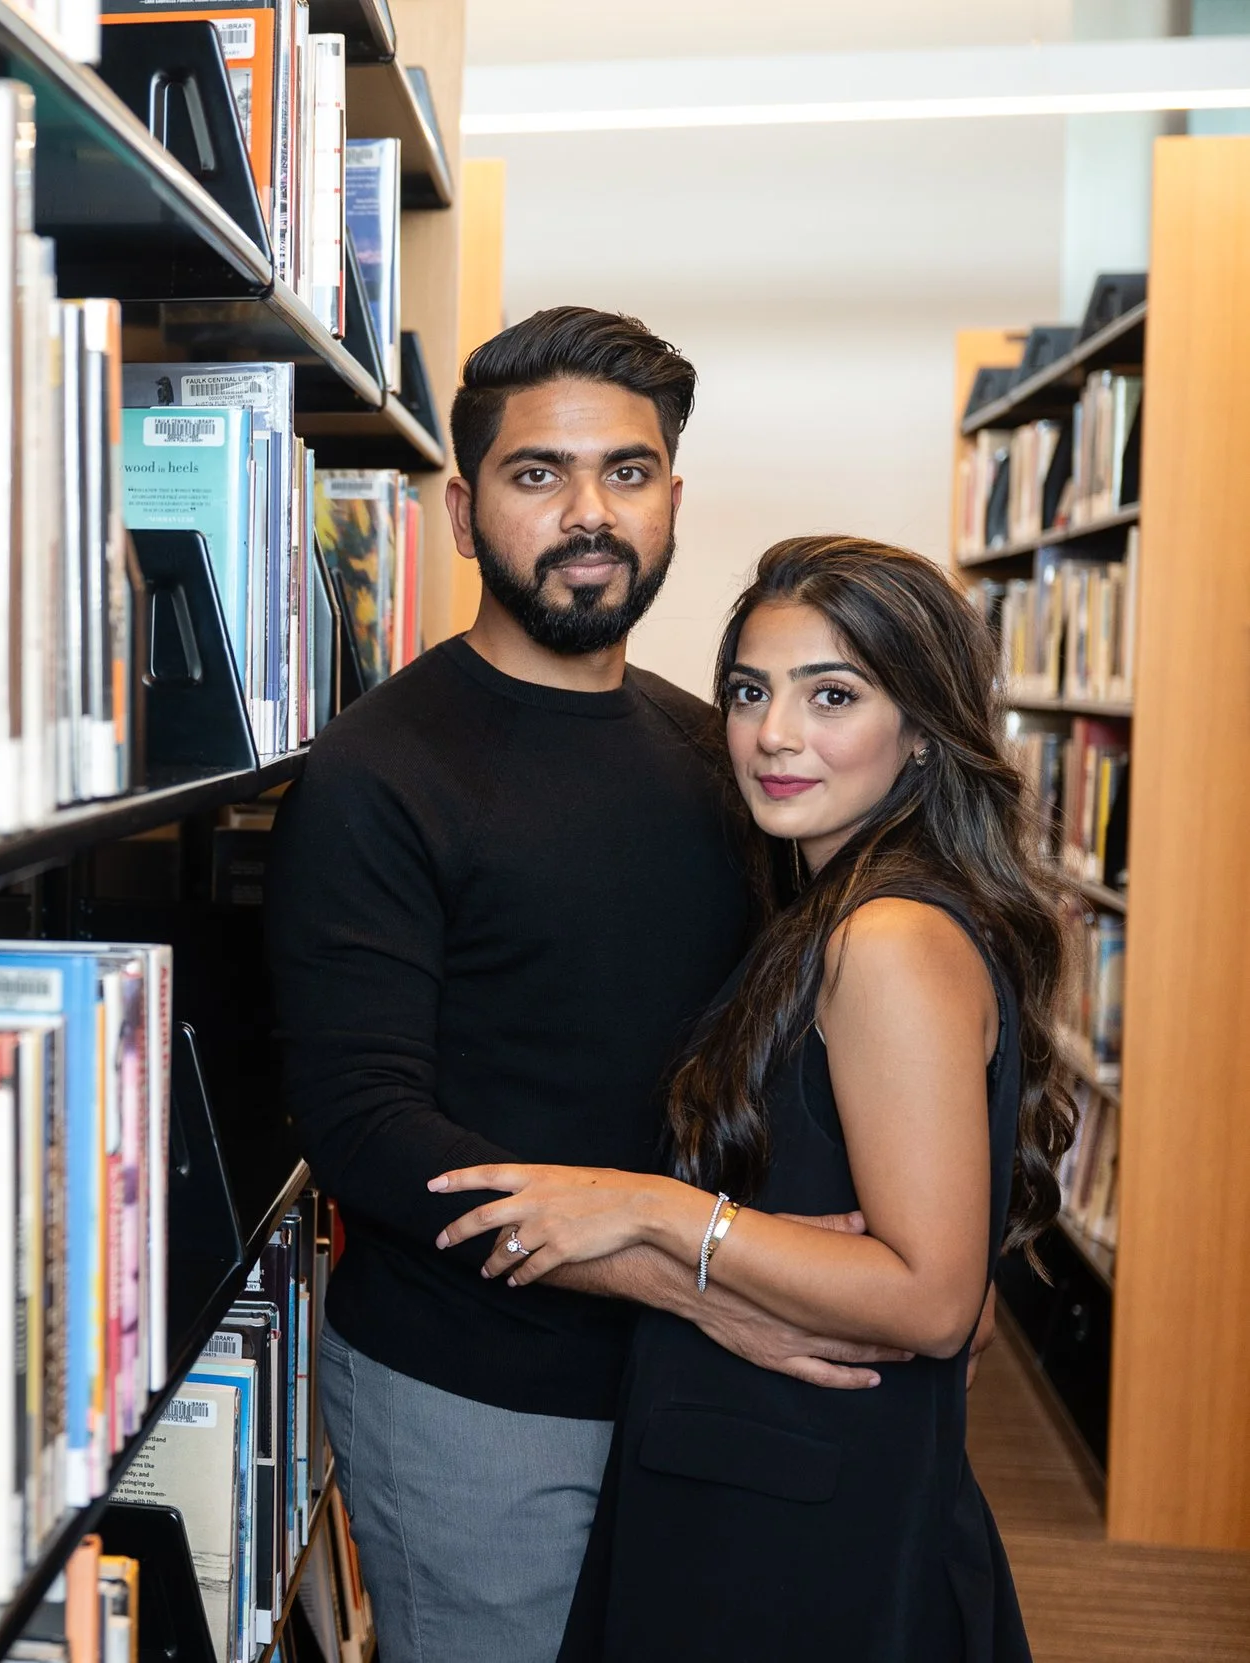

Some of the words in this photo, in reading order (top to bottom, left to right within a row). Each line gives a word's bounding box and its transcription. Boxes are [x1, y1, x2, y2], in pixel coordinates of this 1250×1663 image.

[207, 376, 237, 384] CENTRAL
[123, 461, 155, 473] wood
[168, 461, 199, 473] heels
